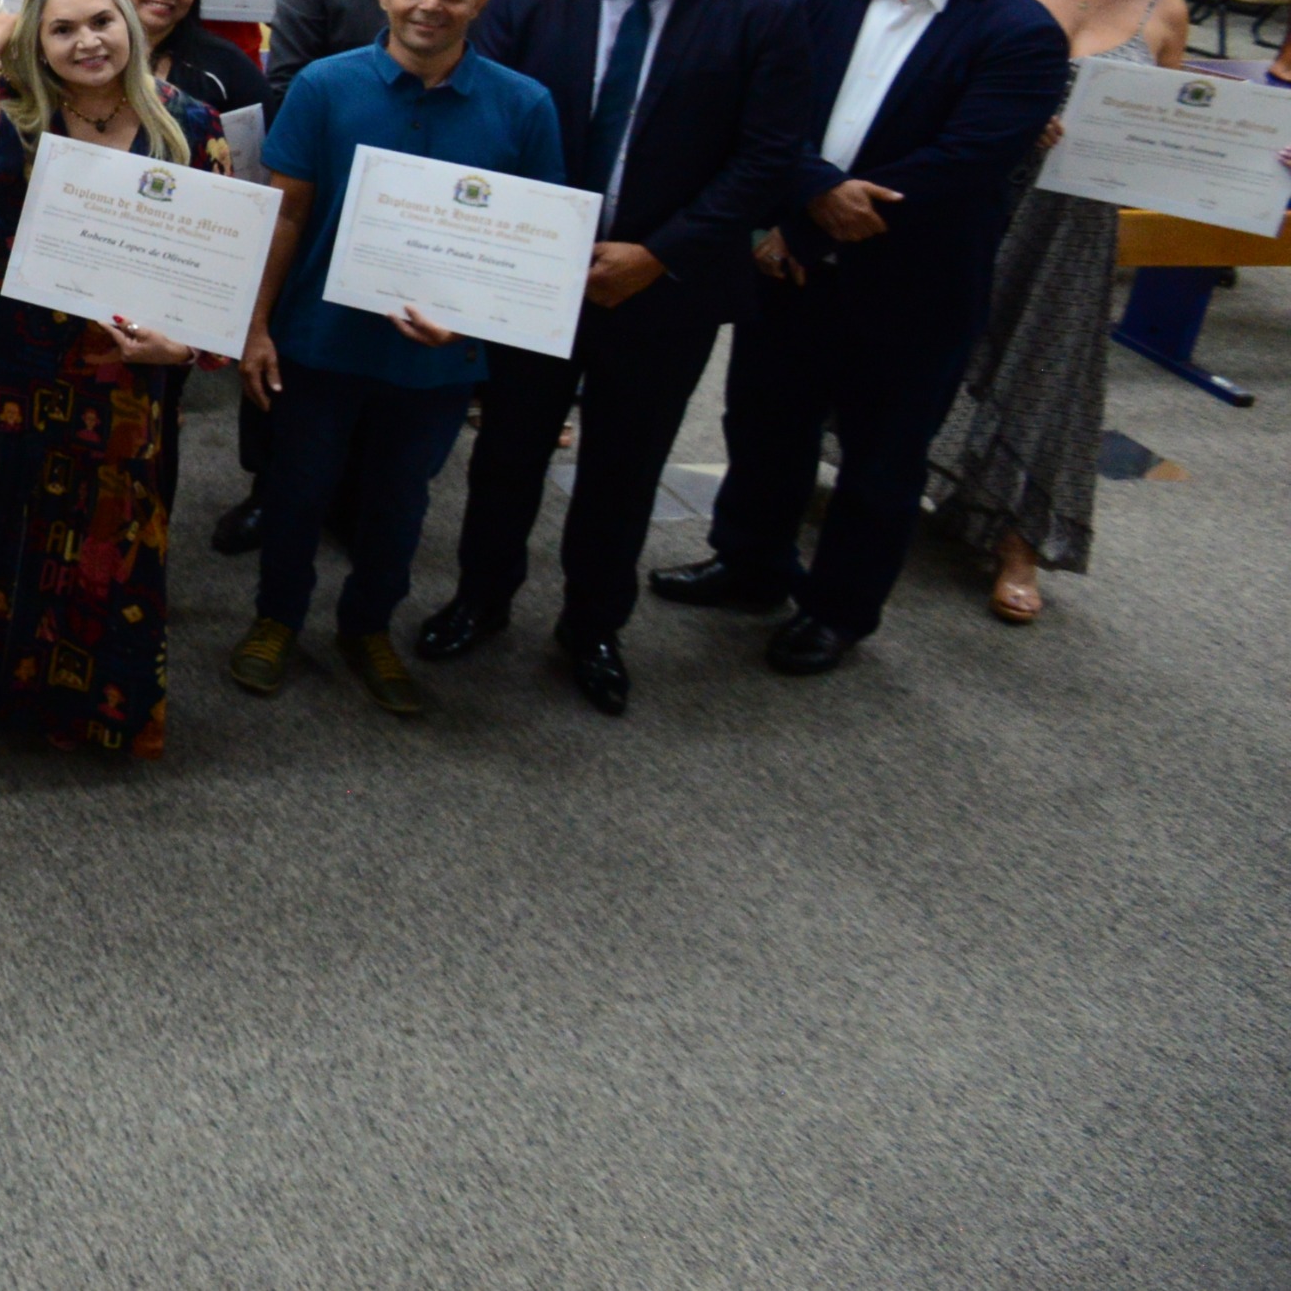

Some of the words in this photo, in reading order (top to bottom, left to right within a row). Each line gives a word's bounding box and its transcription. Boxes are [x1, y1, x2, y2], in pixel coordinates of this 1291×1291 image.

[62, 182, 115, 204] Diploma
[118, 196, 132, 209] de
[135, 200, 176, 222] Honra
[178, 214, 192, 227] ao
[197, 217, 240, 239] Mérito
[377, 193, 431, 213] Diploma
[451, 206, 493, 226] Honra
[514, 221, 559, 241] Mérito
[79, 228, 118, 247] Roberta
[119, 238, 146, 255] Lopes
[148, 246, 161, 257] de
[162, 249, 201, 270] Oliveira
